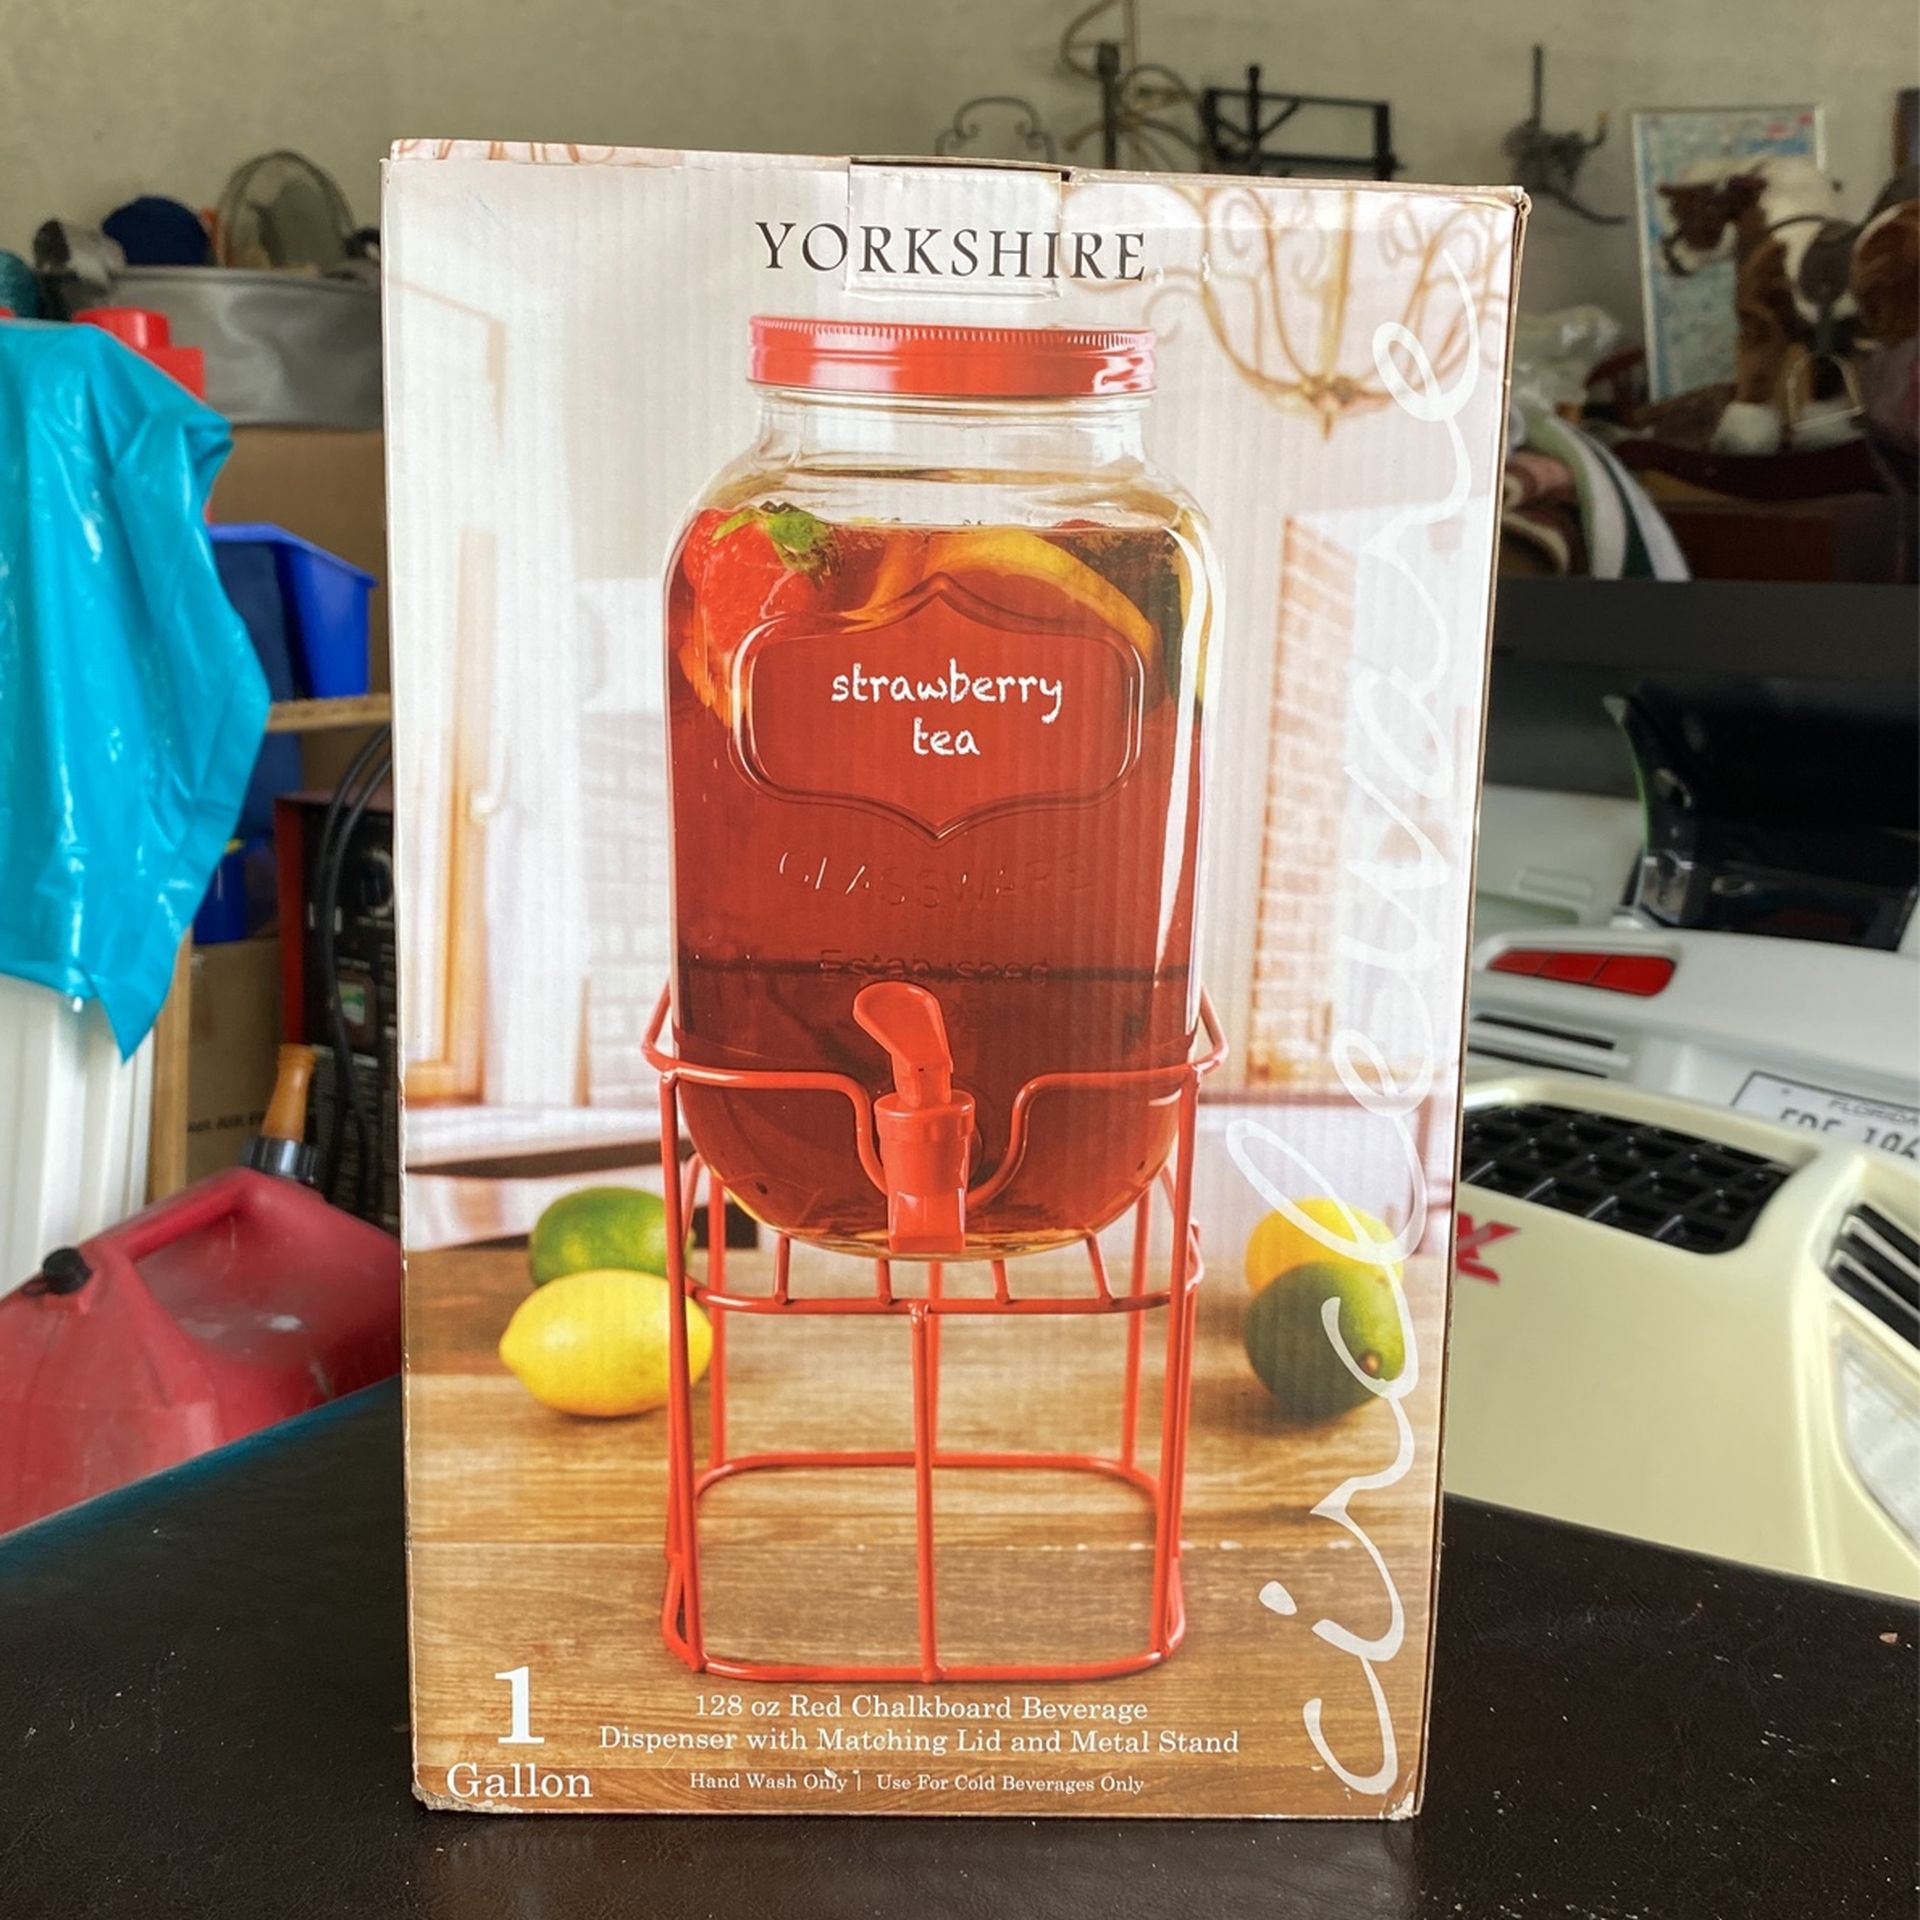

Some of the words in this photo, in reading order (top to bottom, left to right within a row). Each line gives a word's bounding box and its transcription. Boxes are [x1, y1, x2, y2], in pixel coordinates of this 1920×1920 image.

[755, 221, 1146, 282] YORKSHIRE
[831, 657, 1063, 724] strawberry
[912, 716, 981, 756] tea
[494, 1666, 545, 1744] 1
[695, 1694, 743, 1717] 128
[750, 1700, 781, 1717] oz
[789, 1693, 843, 1717] Red
[851, 1694, 1013, 1719] Chalkboard
[1020, 1695, 1149, 1725] Beverage
[598, 1725, 738, 1754] Dispenser
[745, 1727, 808, 1751] with
[816, 1727, 949, 1757] Matching
[956, 1728, 1002, 1752] Lid
[1010, 1729, 1062, 1753] and
[1069, 1729, 1150, 1753] Metal
[1157, 1730, 1240, 1754] Stand
[446, 1762, 593, 1798] Gallon
[690, 1772, 741, 1789] Hand
[746, 1773, 798, 1790] Wash
[803, 1770, 848, 1793] Only
[876, 1773, 912, 1790] Use
[916, 1774, 950, 1791] For
[954, 1774, 996, 1792] Cold
[1001, 1774, 1095, 1795] Beverages
[1100, 1775, 1145, 1795] Only
